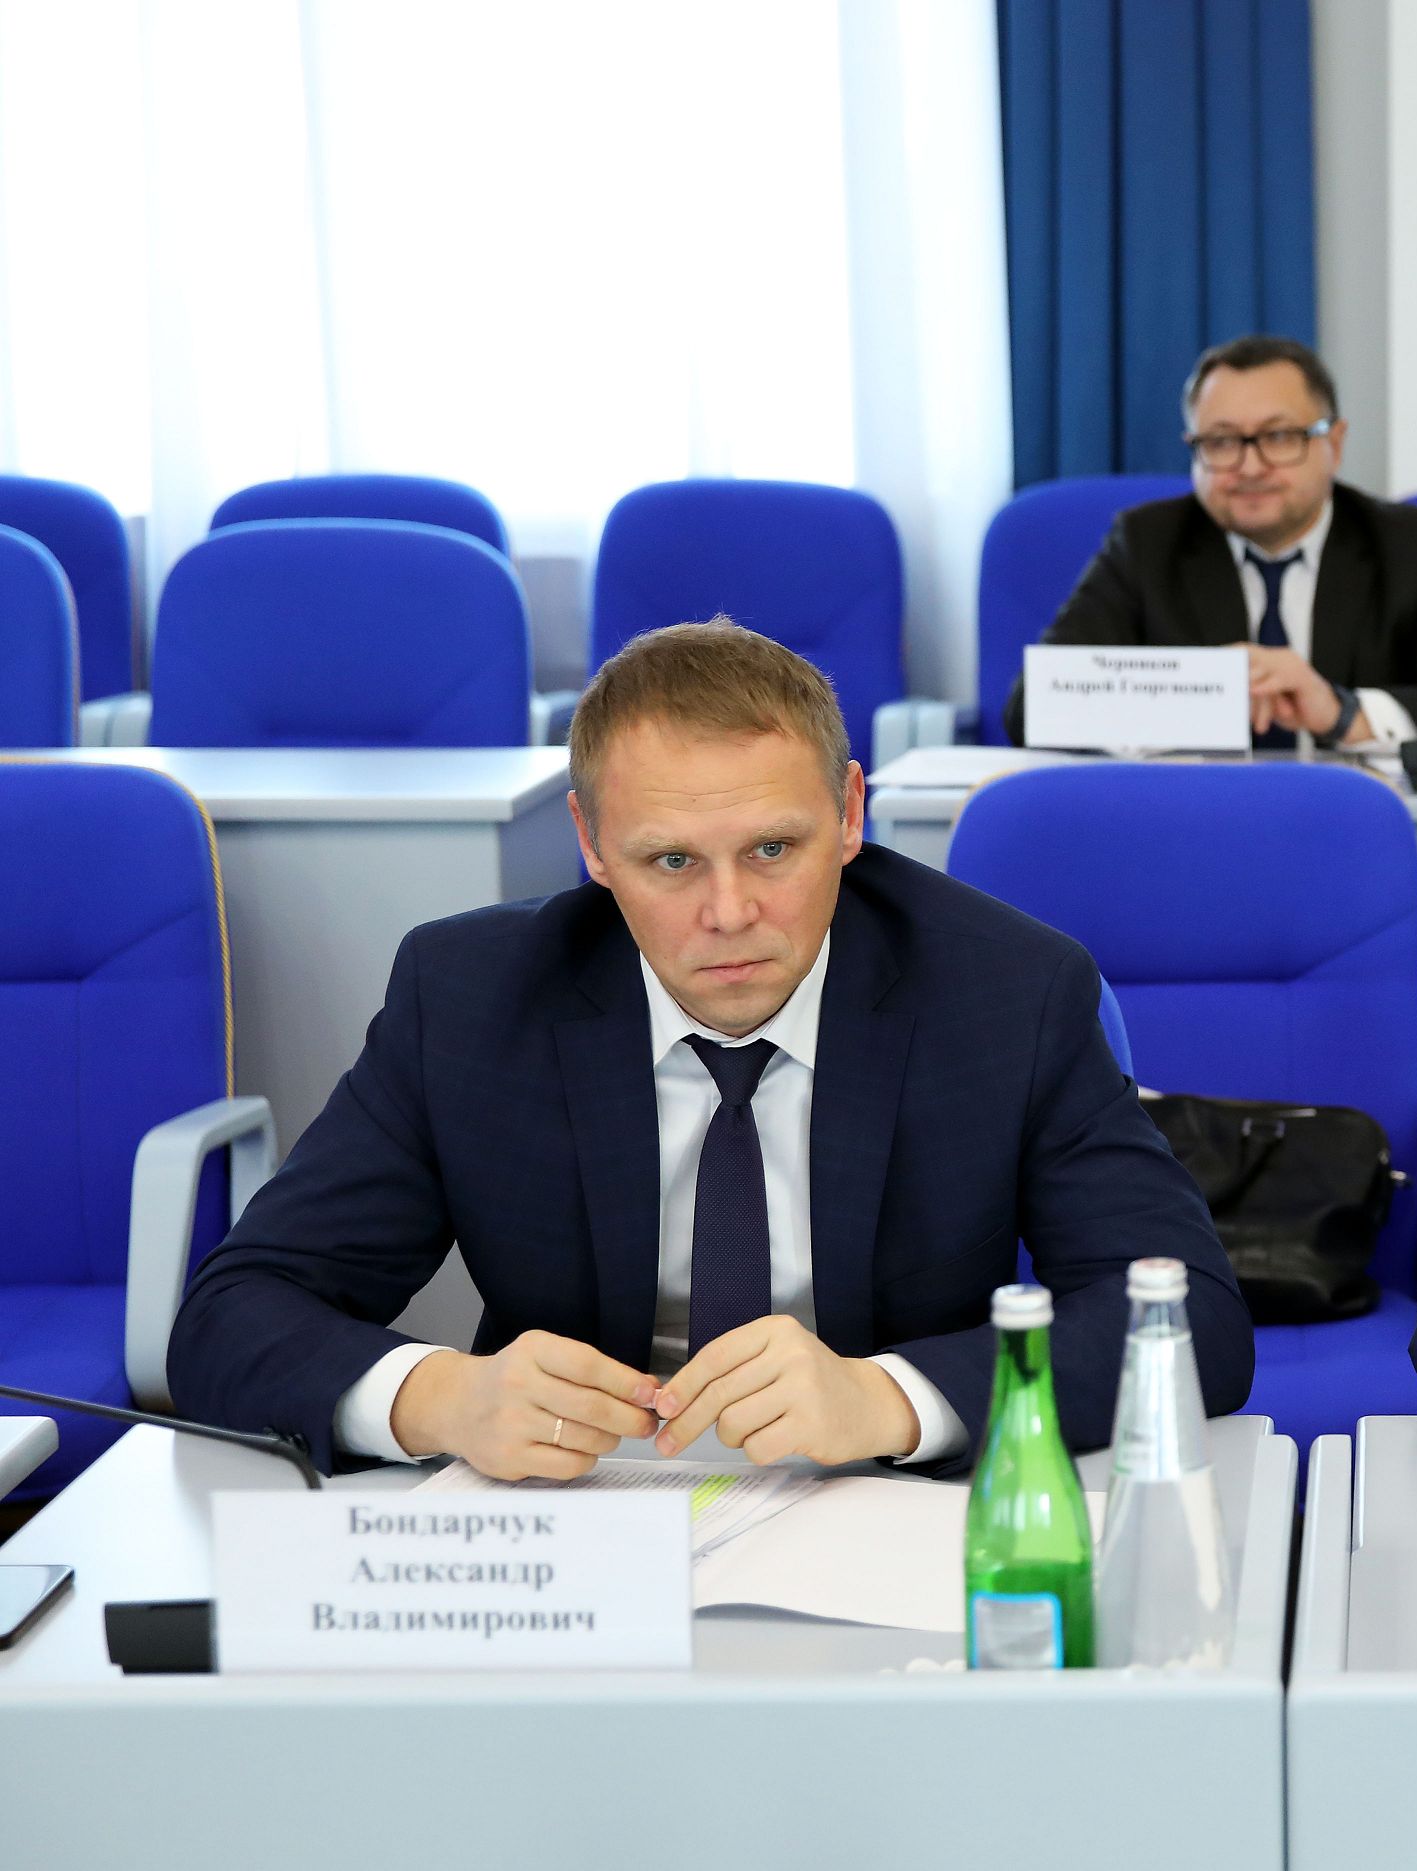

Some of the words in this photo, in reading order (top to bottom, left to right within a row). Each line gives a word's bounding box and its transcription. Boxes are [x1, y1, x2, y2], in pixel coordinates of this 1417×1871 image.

[1049, 679, 1116, 697] Андрей
[347, 1505, 556, 1543] Бондарчук
[350, 1556, 556, 1593] Александр
[311, 1602, 596, 1639] Владимирович
